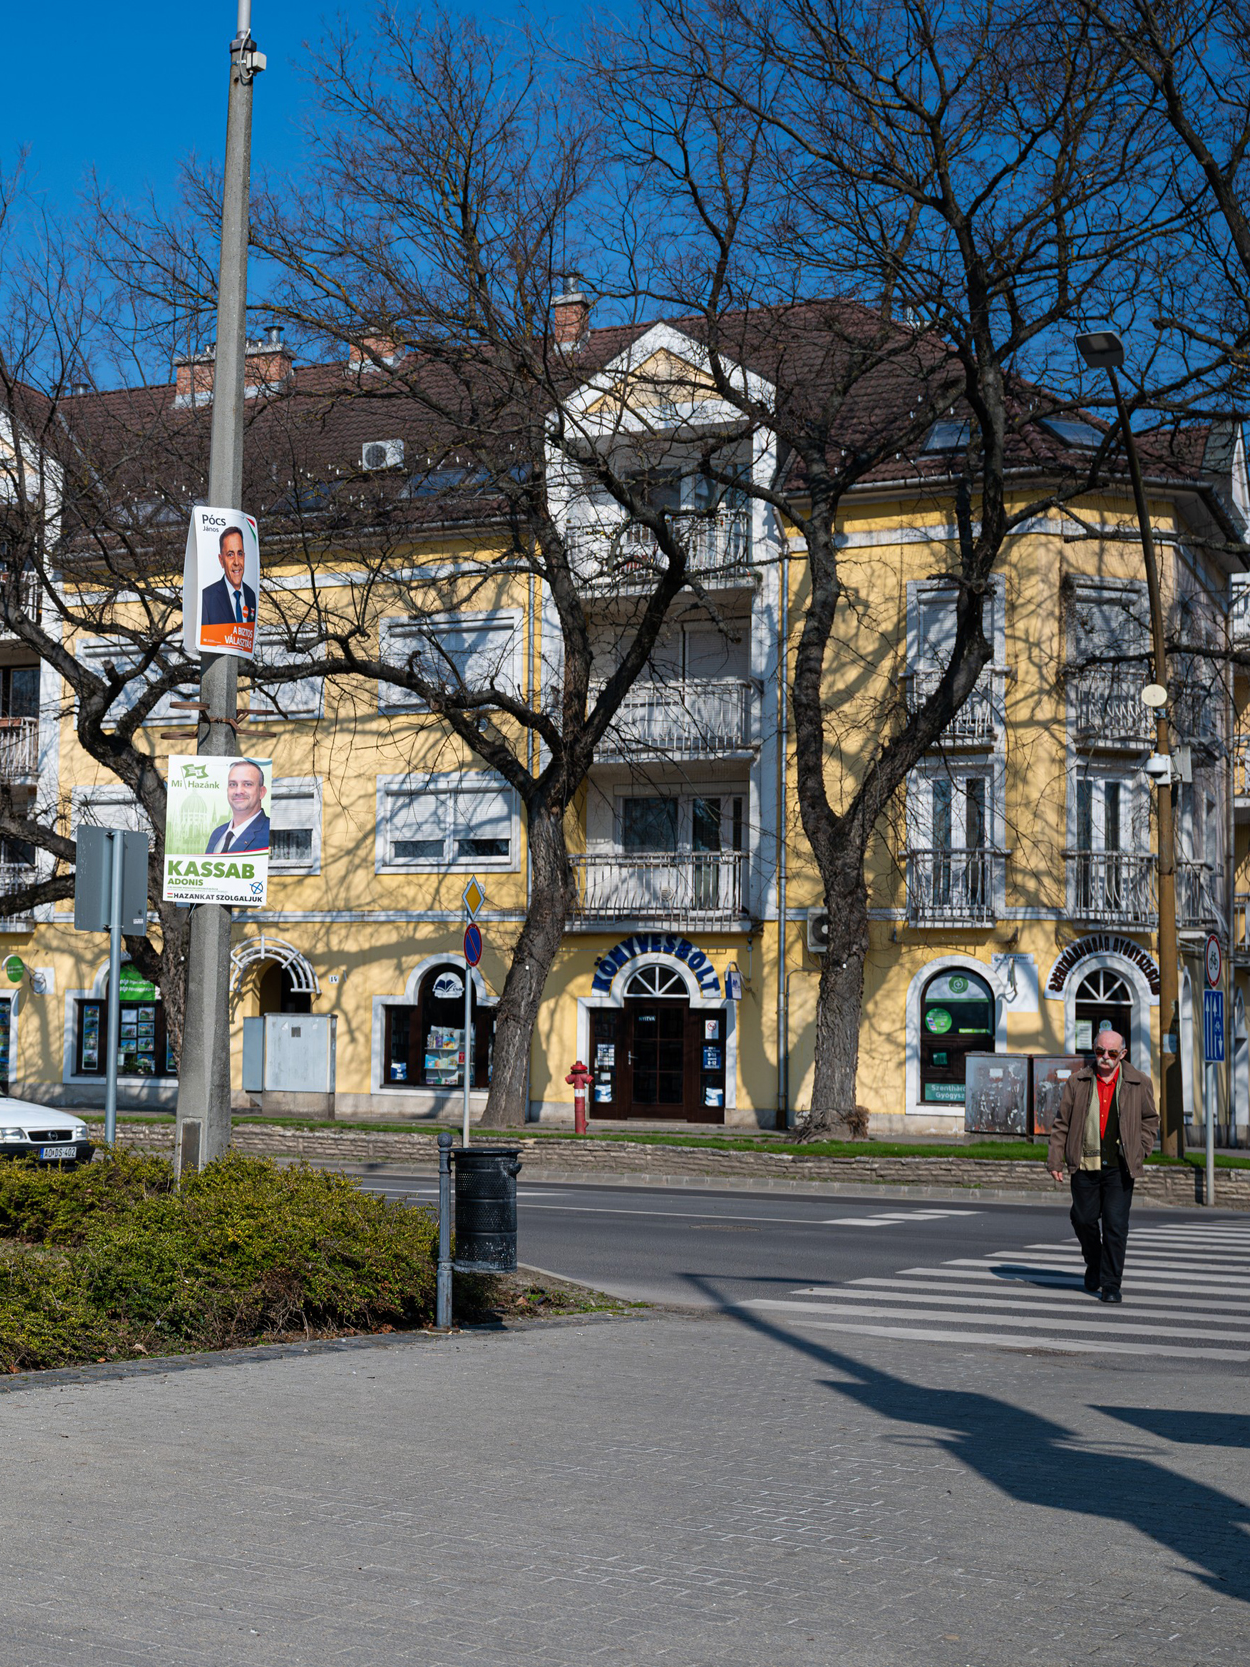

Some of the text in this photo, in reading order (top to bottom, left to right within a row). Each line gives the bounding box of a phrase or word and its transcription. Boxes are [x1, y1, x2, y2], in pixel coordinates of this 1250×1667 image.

[202, 514, 226, 526] Pócs
[233, 626, 253, 638] A BIZTOS
[224, 634, 252, 648] VÁLASZTÁS
[188, 780, 219, 789] Hazánk
[167, 860, 255, 879] KASSAB
[167, 878, 203, 886] ADONIS
[592, 933, 721, 992] KÖNYVESBOLT
